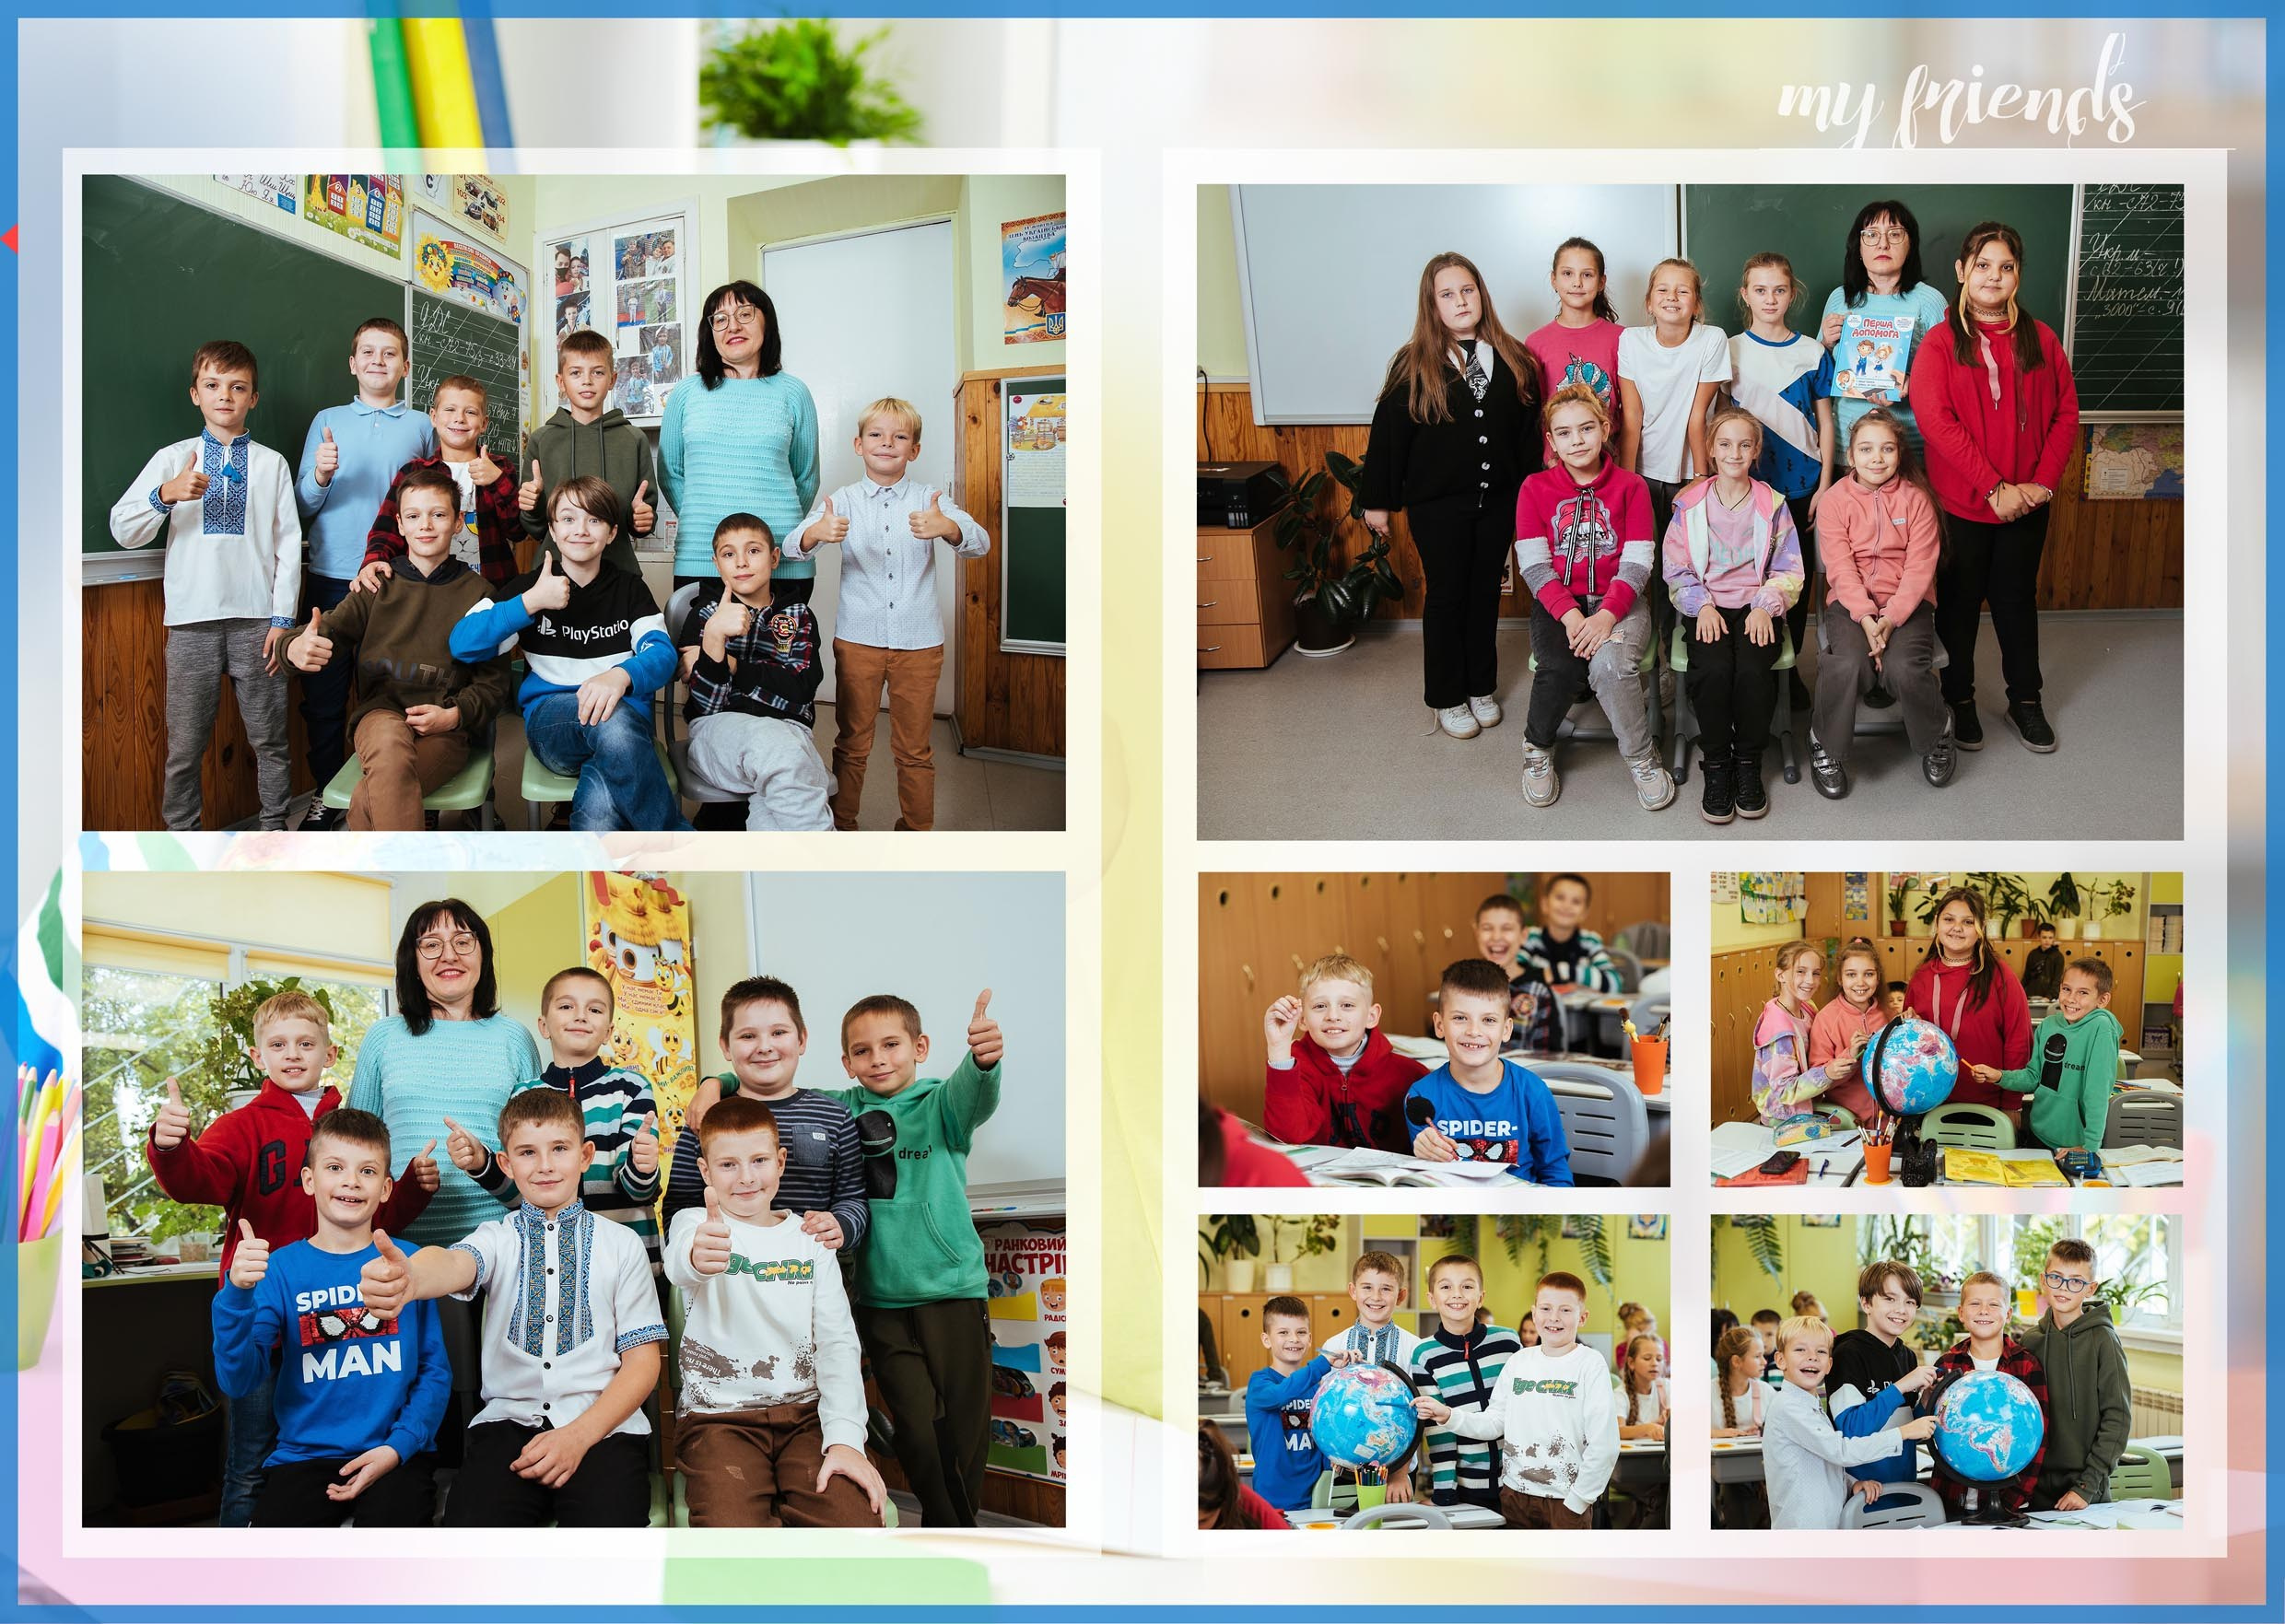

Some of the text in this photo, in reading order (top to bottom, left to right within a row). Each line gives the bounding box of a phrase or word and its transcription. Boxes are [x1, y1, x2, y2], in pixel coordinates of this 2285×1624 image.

[457, 189, 467, 199] 103
[497, 195, 505, 204] 102
[496, 214, 504, 223] 104
[1863, 318, 1892, 329] ПЕРША
[1851, 328, 1900, 339] ДОПОМОГА
[562, 619, 629, 644] PlayStatio
[670, 1065, 695, 1083] ВАЖЛИВІ
[1437, 1119, 1517, 1137] SPIDER-
[995, 1236, 1066, 1251] РАНКОВИЙ
[302, 1340, 402, 1384] MAN
[685, 1356, 696, 1364] no
[702, 1362, 721, 1377] There
[1281, 1398, 1313, 1411] PIDE
[1284, 1431, 1312, 1452] MA
